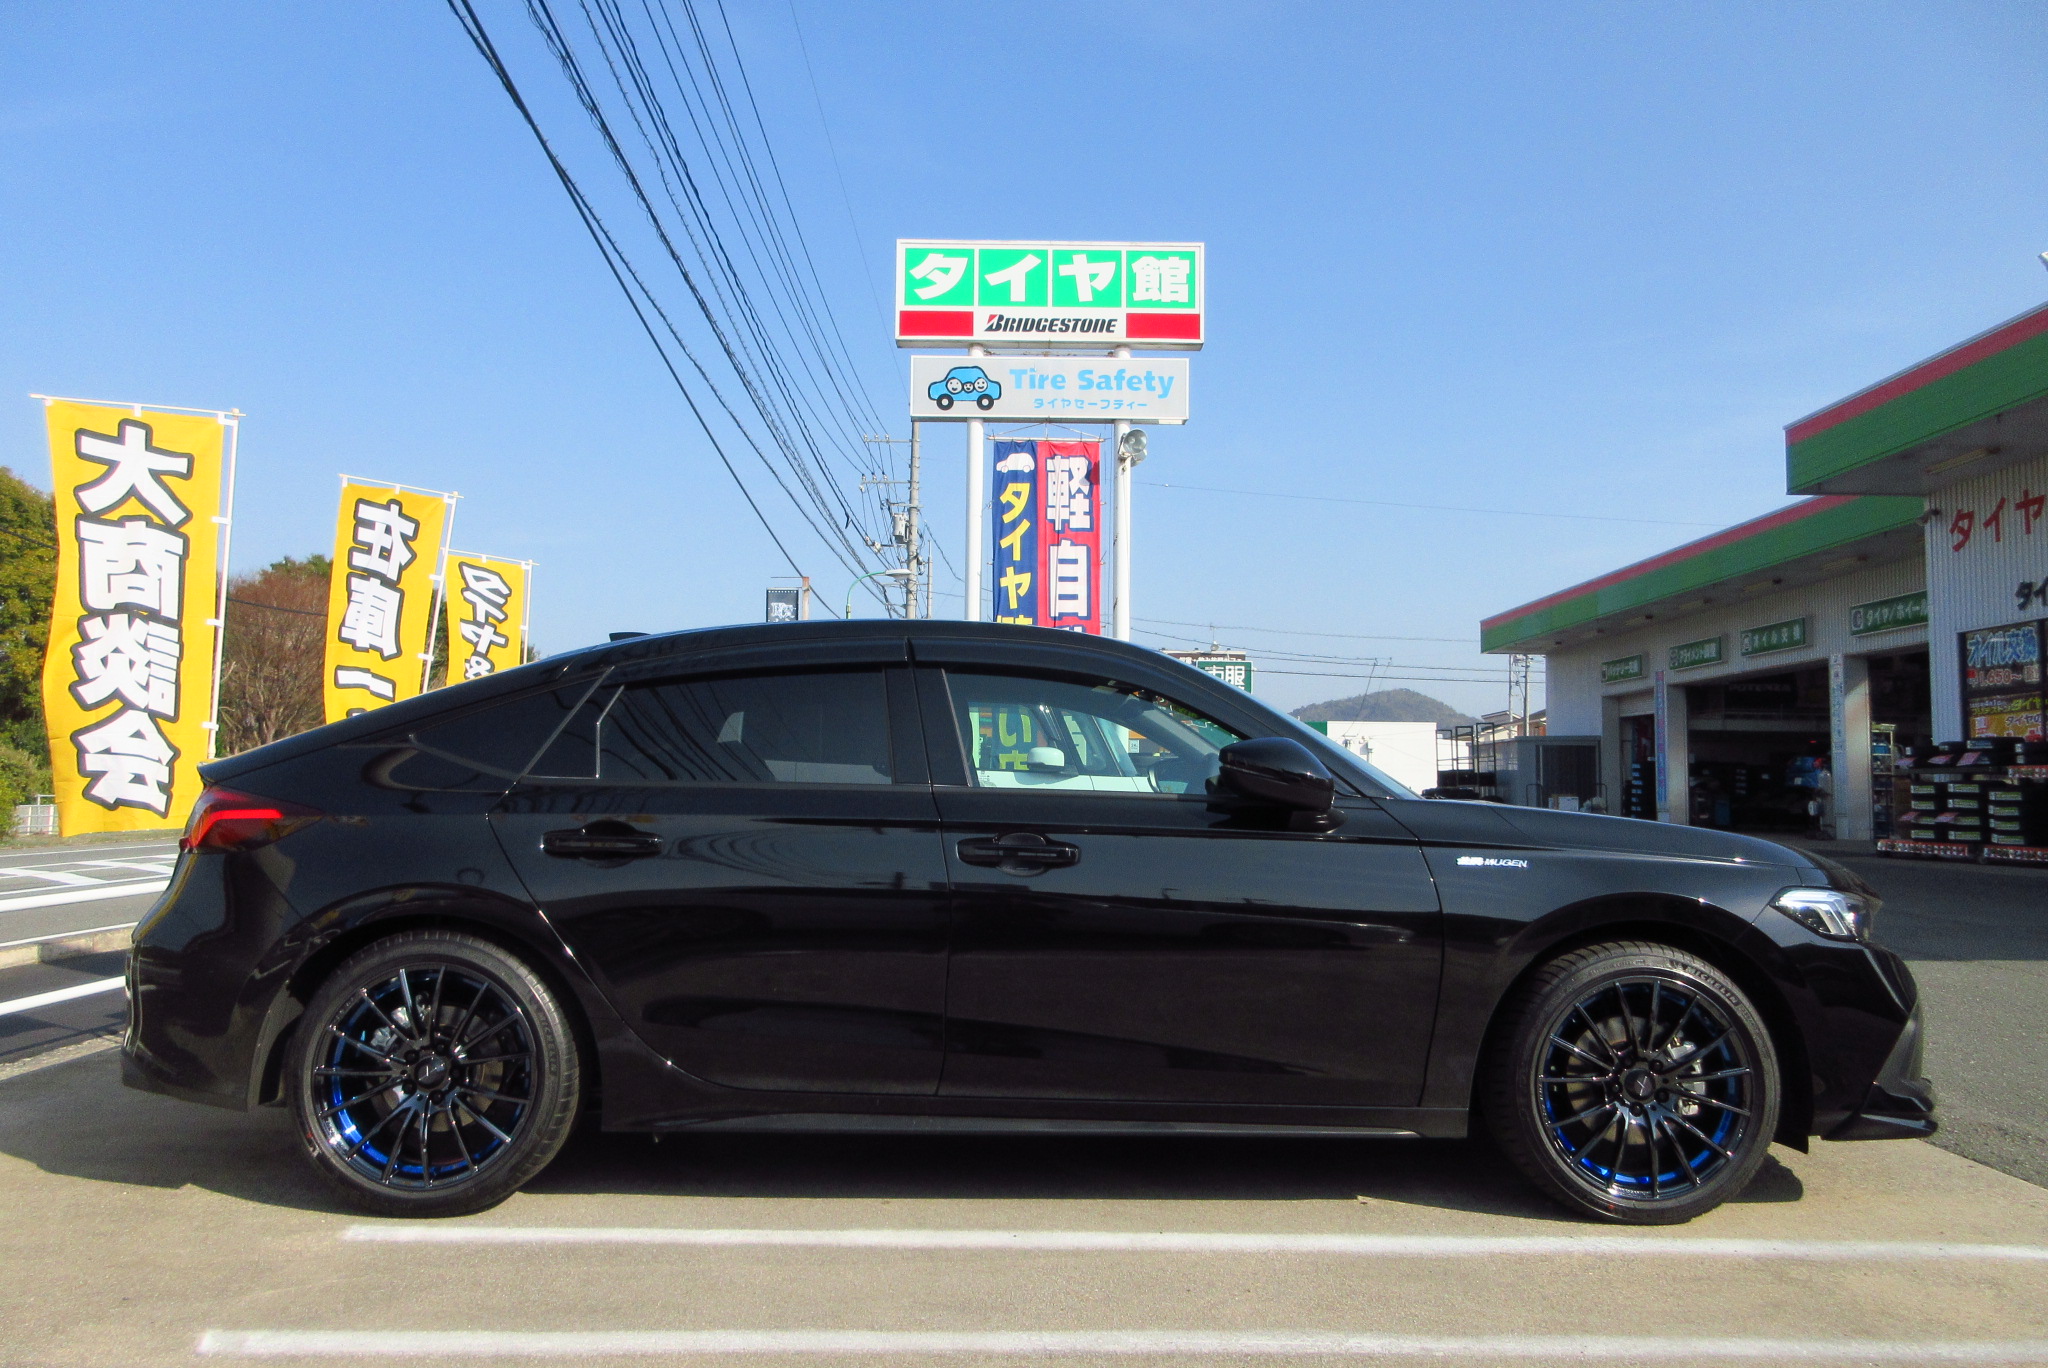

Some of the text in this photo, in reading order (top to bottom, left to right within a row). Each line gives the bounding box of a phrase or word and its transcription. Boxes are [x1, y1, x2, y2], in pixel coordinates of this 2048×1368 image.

[909, 253, 1190, 303] タイヤ館
[984, 314, 1118, 333] BRIDGESTONE
[1009, 368, 1174, 399] Tire Safety
[1033, 397, 1147, 410] タイヤセーフティー
[1949, 489, 2046, 552] タイヤ
[1046, 455, 1092, 633] 軽自
[1484, 858, 1527, 868] MUGEN
[1683, 965, 1740, 1006] MICHELIN
